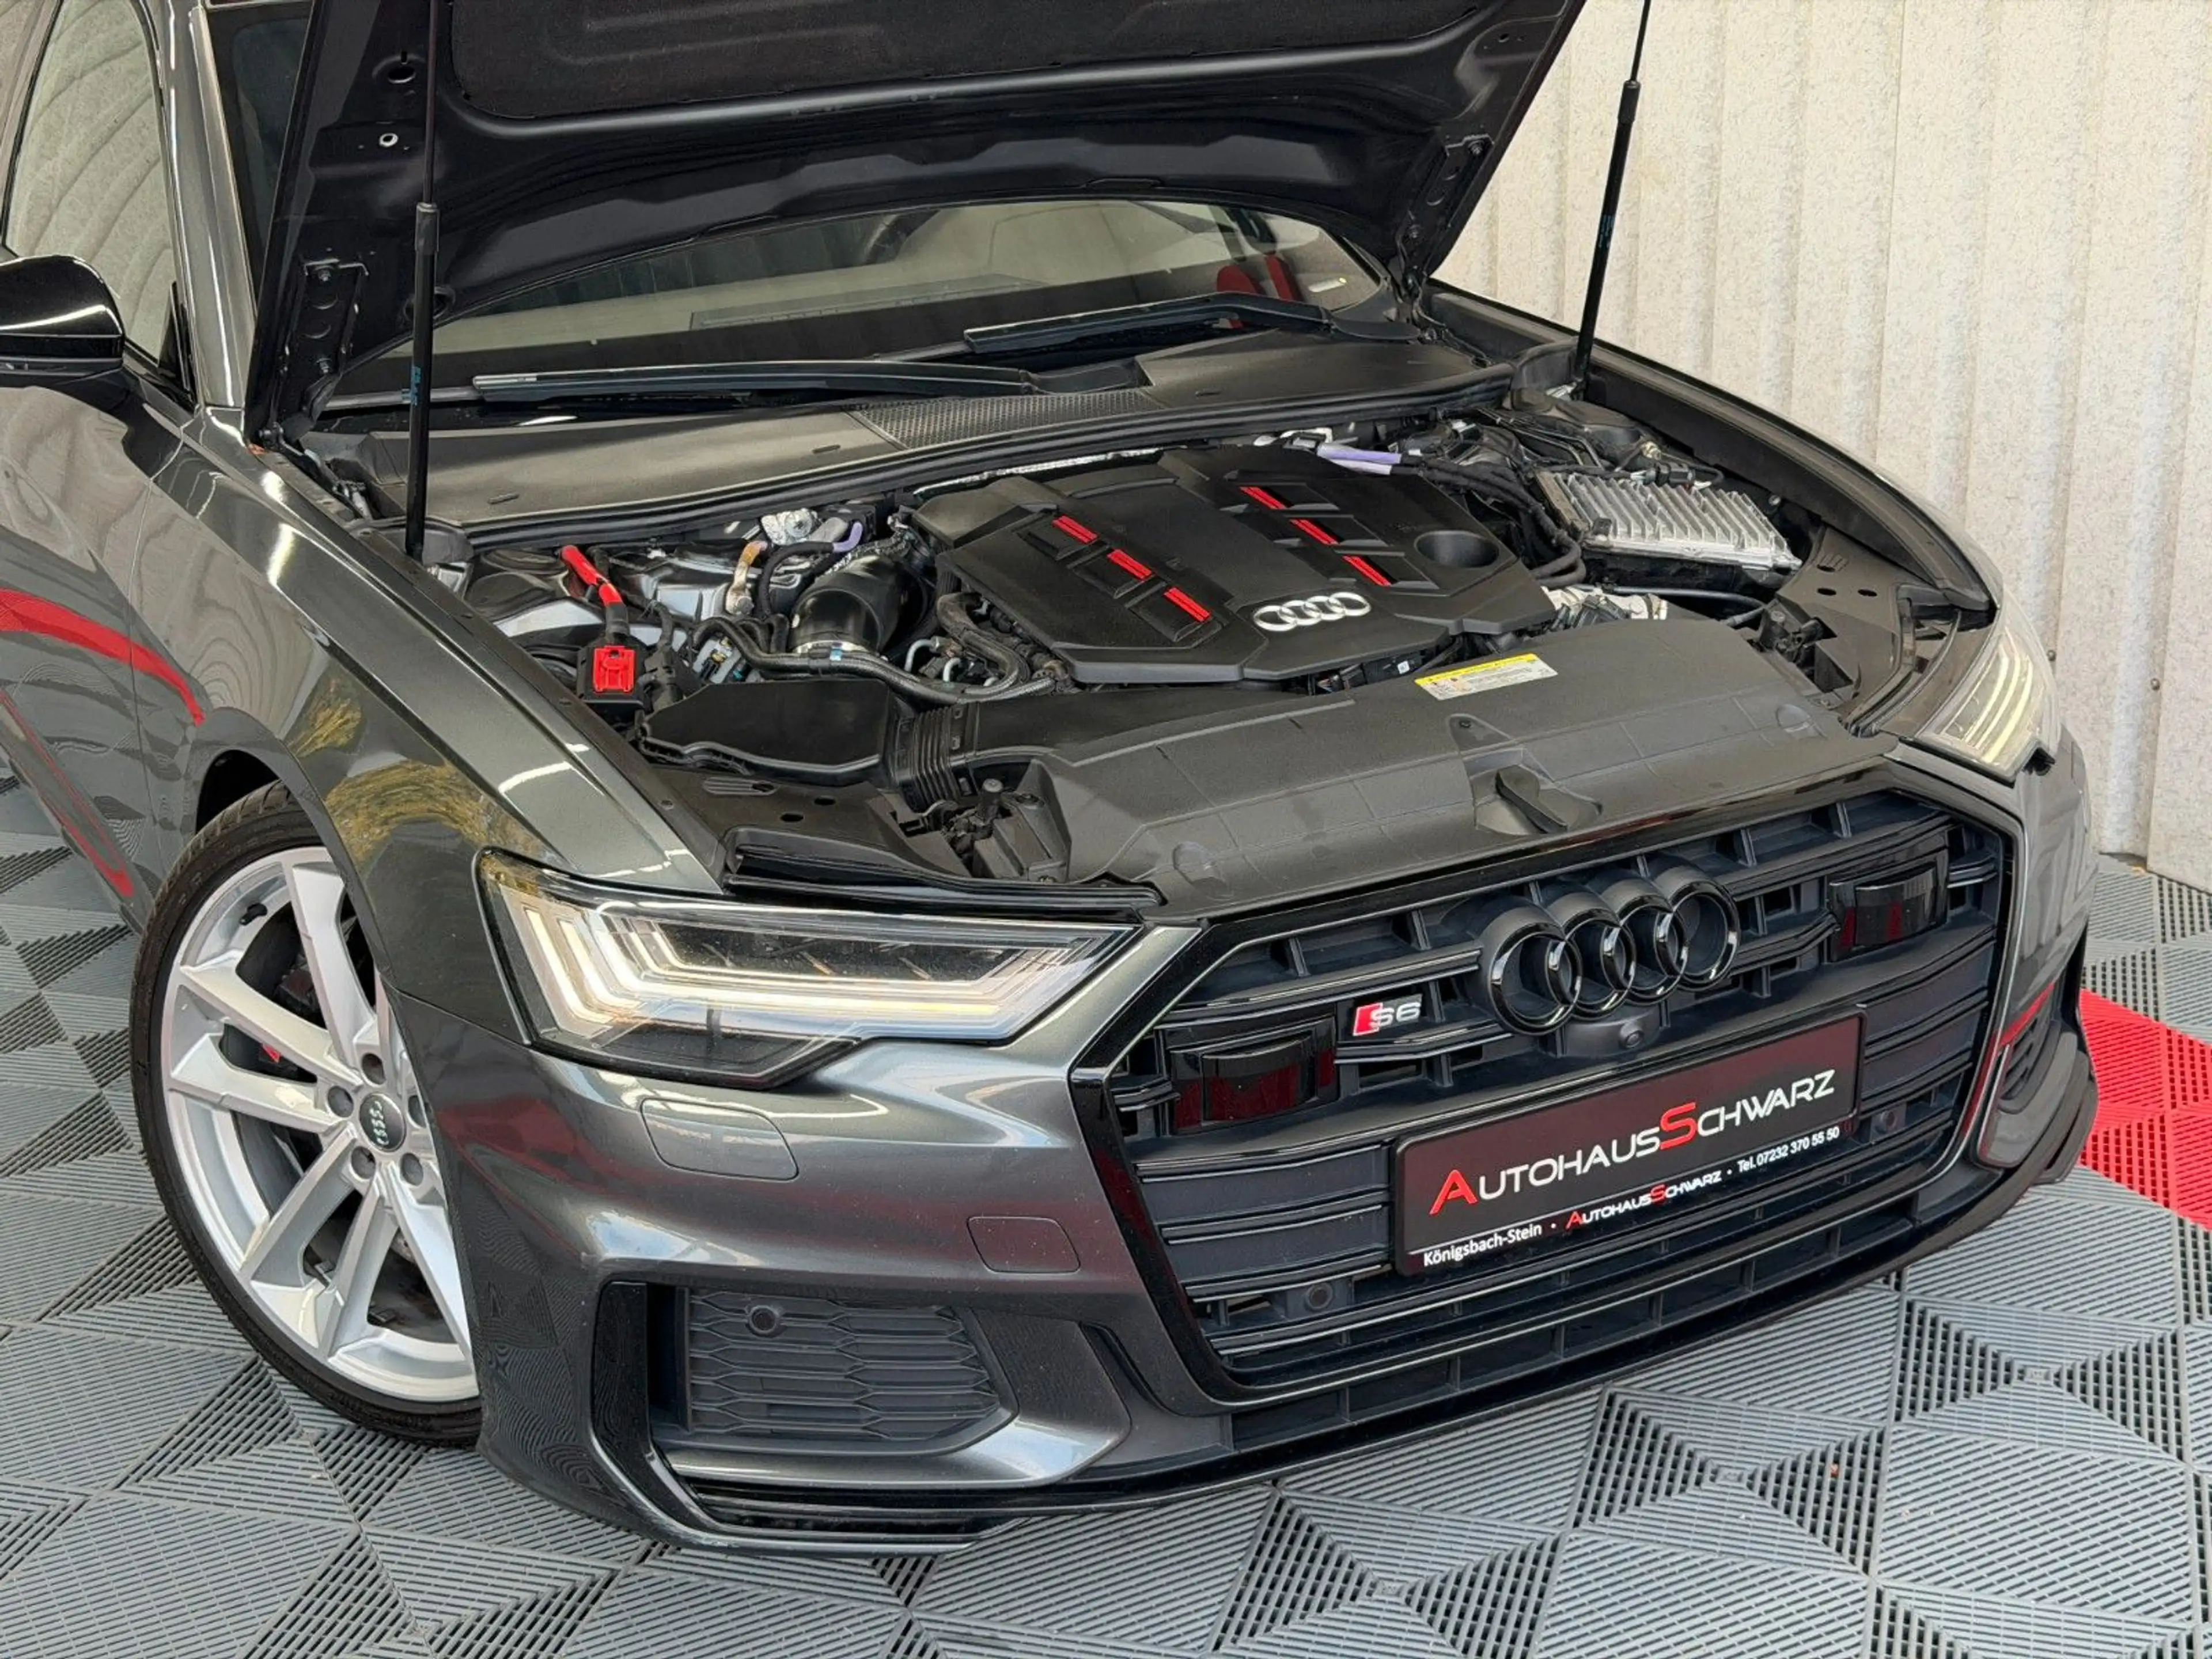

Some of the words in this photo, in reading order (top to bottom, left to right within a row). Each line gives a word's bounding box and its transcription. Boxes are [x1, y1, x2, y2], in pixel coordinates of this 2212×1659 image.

[1369, 1002, 1422, 1028] S6
[1423, 1223, 1542, 1267] Königsbach-Stein
[1756, 1144, 1789, 1166] 07232
[1790, 1137, 1810, 1154] 370
[1811, 1131, 1825, 1147] 55
[1826, 1126, 1840, 1142] 50
